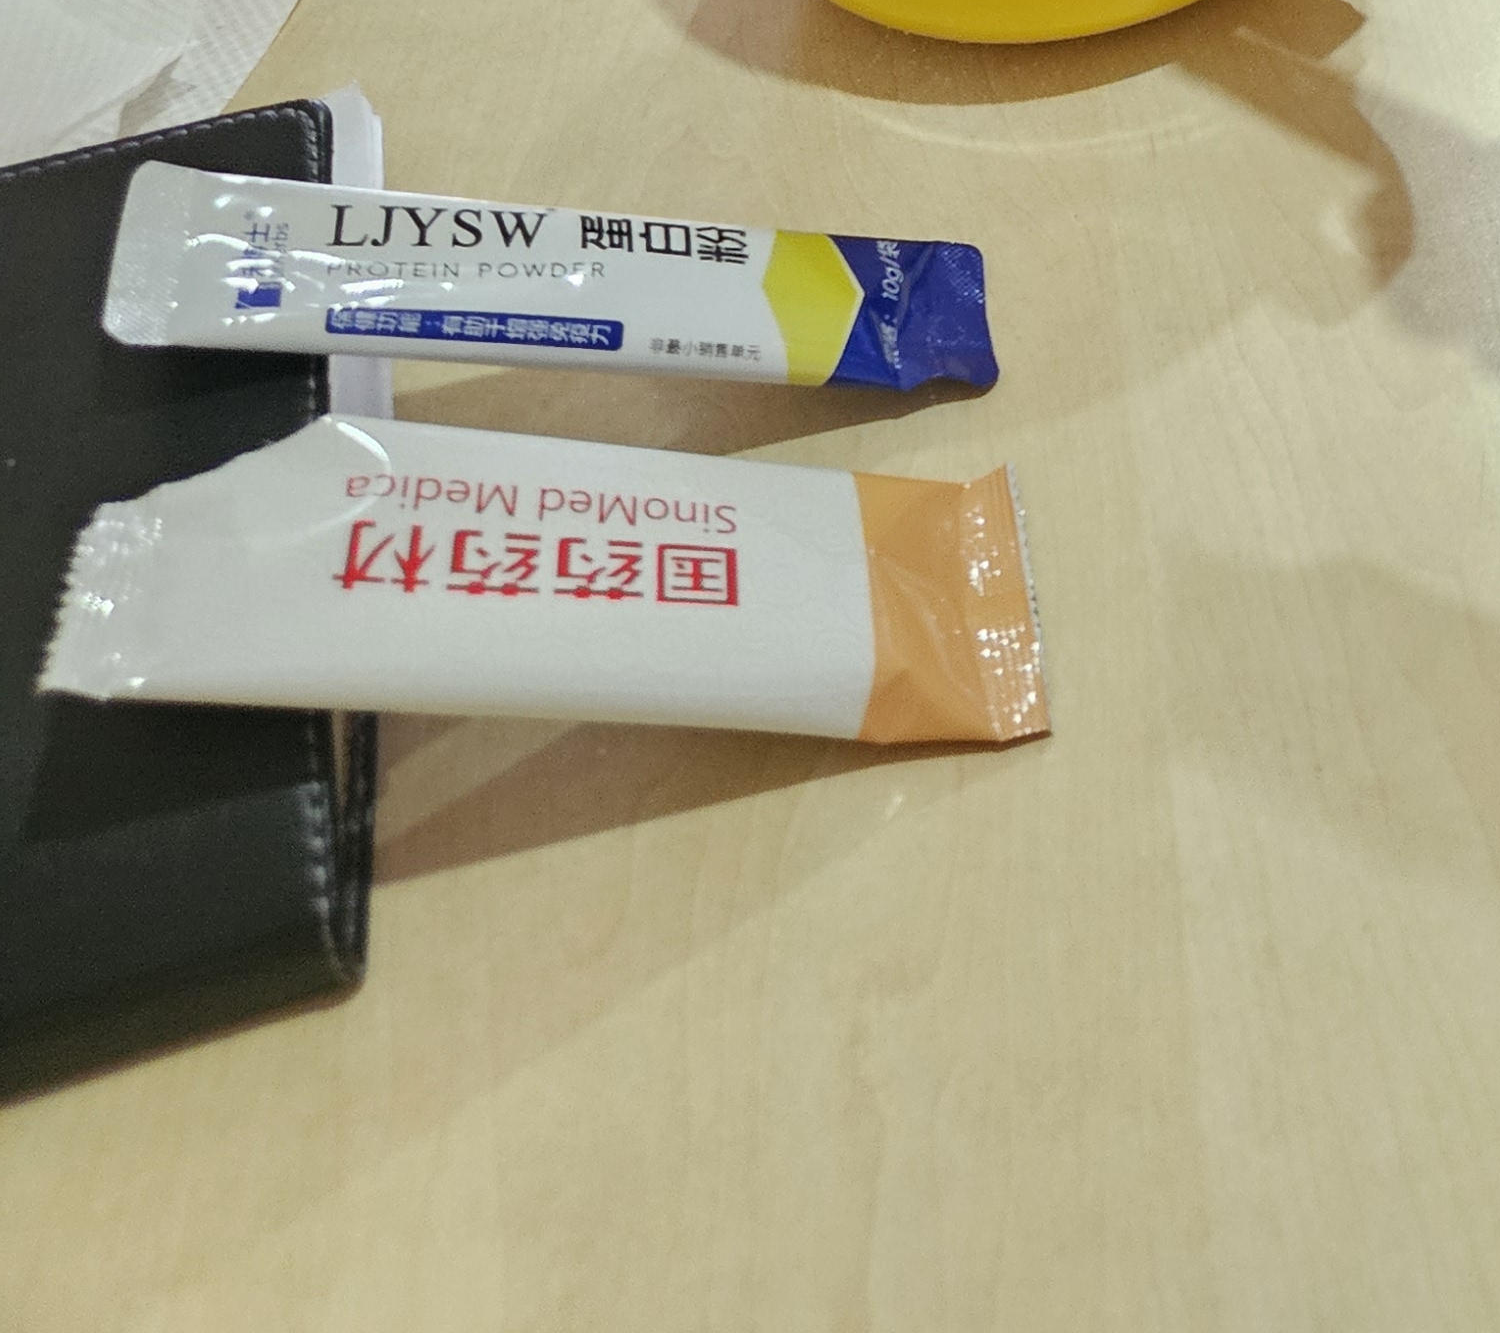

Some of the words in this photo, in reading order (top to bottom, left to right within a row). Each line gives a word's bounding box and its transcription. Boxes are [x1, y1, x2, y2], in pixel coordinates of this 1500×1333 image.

[324, 203, 548, 249] LJYSW
[580, 214, 749, 265] 蛋白粉
[326, 259, 460, 279] PROTEIN
[477, 261, 606, 279] POWDER
[344, 473, 518, 517] Medica
[537, 487, 738, 535] SinoMed
[332, 519, 738, 607] 国药药材
